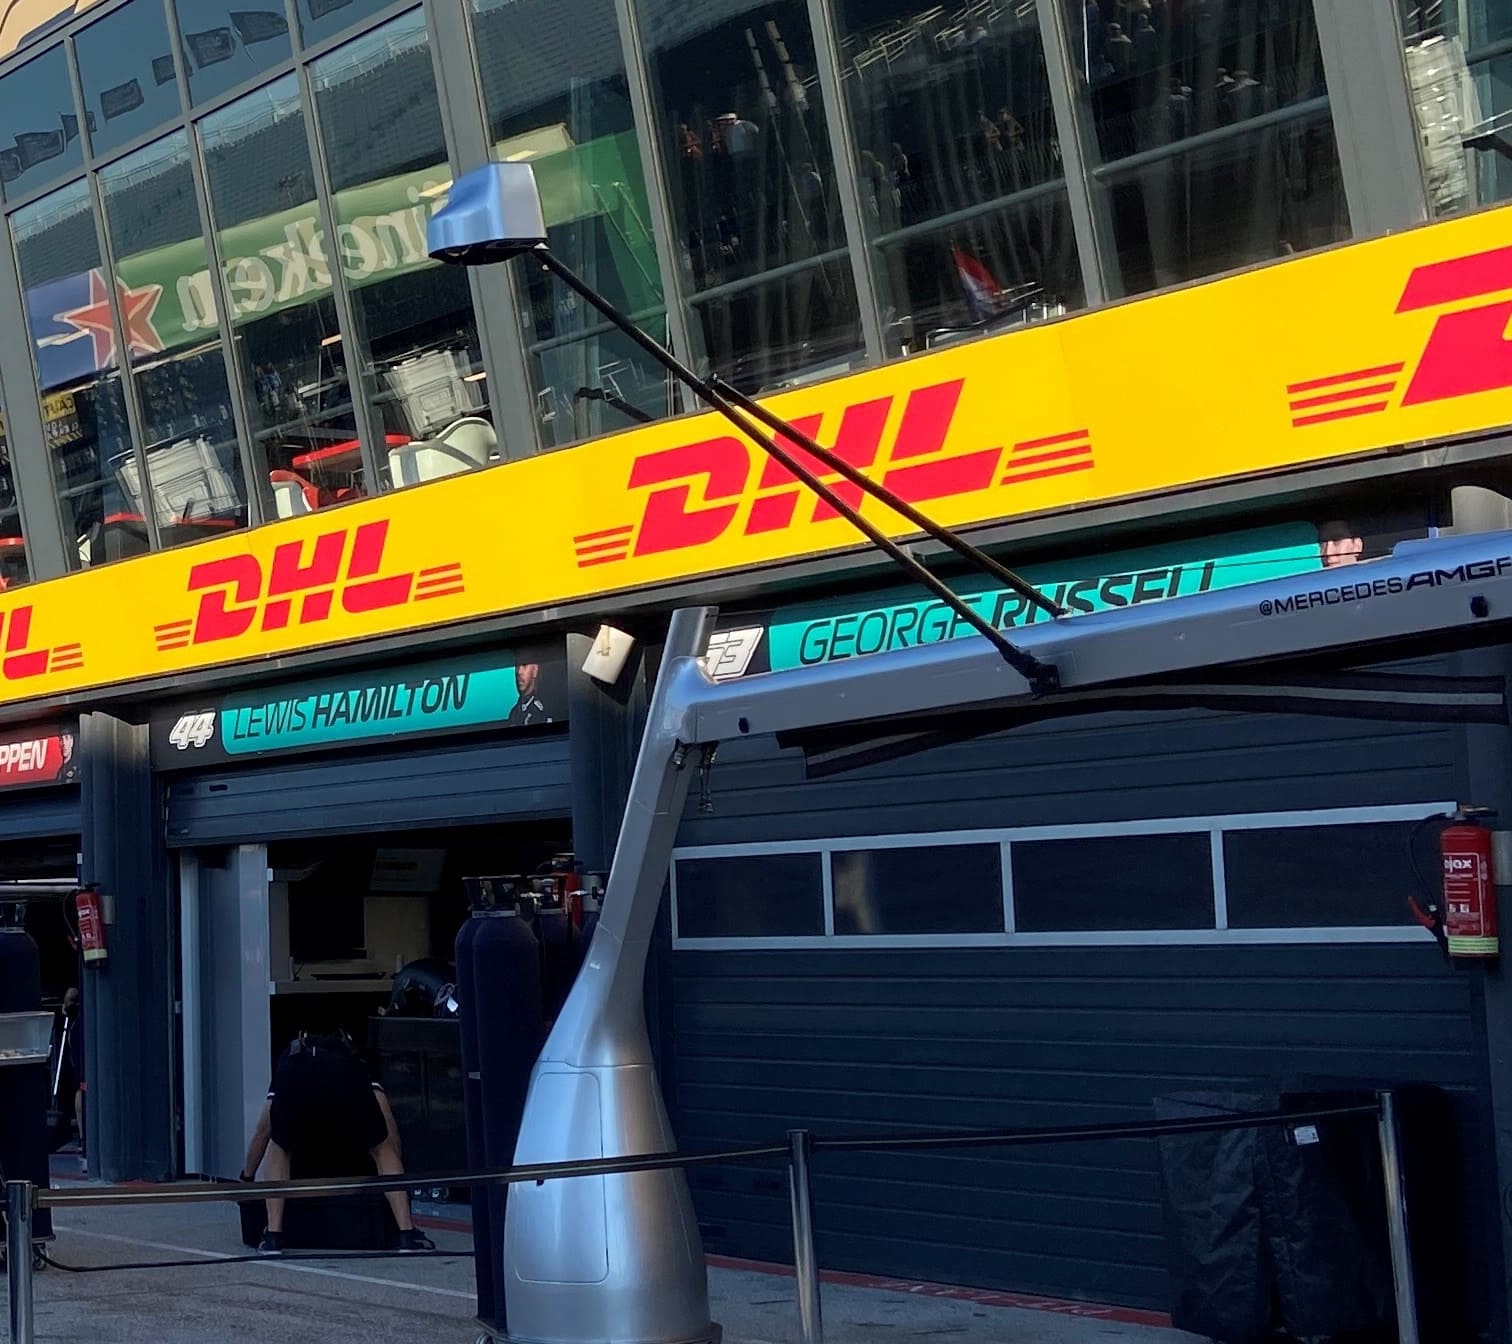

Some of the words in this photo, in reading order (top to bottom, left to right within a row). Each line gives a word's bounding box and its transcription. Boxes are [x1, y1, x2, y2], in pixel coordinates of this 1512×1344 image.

[627, 377, 1004, 557] DHL
[187, 519, 414, 645] DHL
[169, 709, 217, 751] 44
[232, 698, 308, 741] LEWIS
[311, 673, 470, 729] HAMILTON
